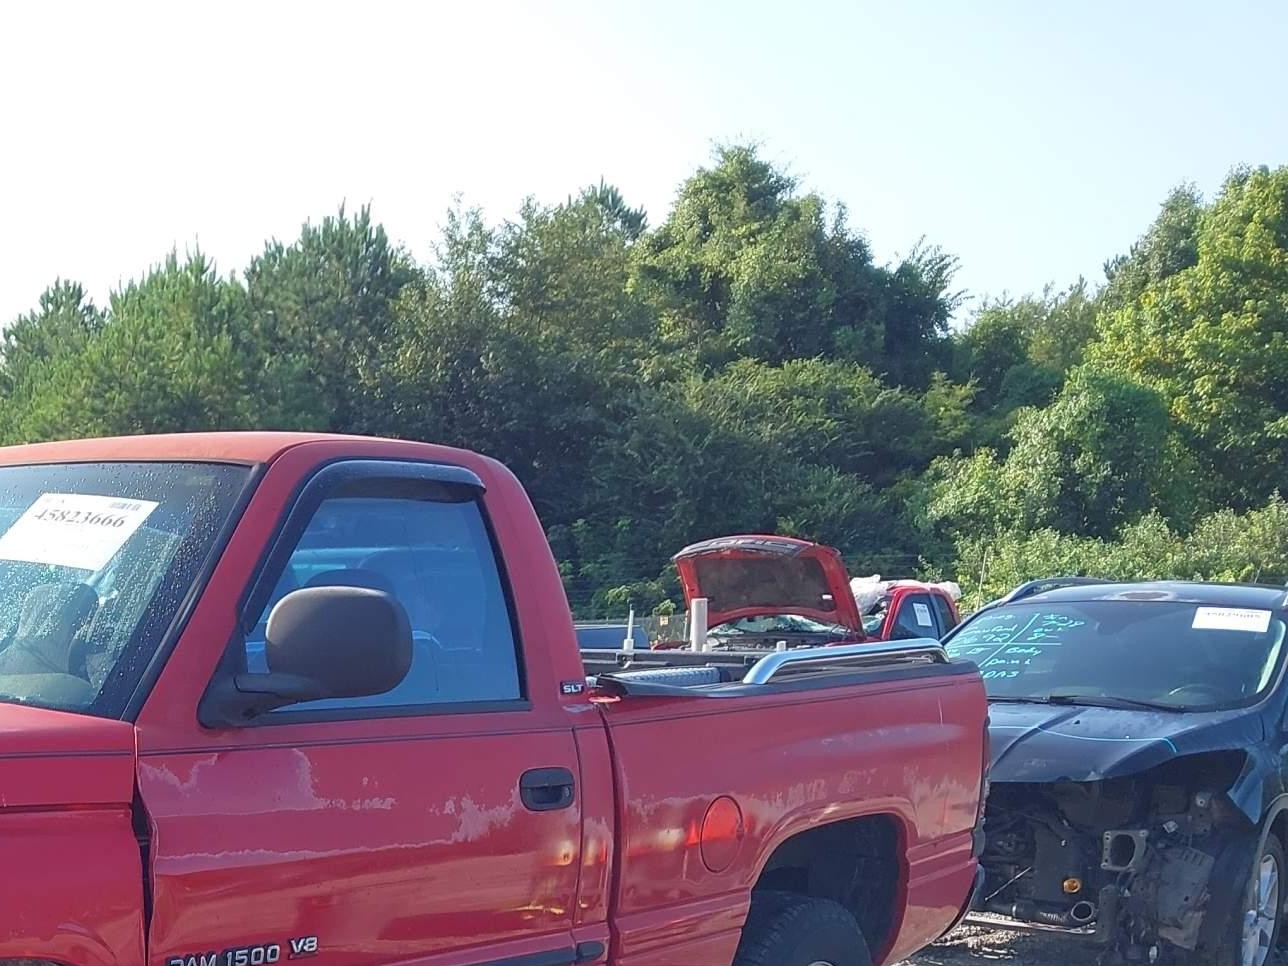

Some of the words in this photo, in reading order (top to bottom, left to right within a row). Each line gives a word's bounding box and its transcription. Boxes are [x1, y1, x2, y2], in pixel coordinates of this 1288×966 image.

[34, 507, 126, 529] 45823666
[563, 684, 584, 693] SLT
[290, 936, 318, 954] V8
